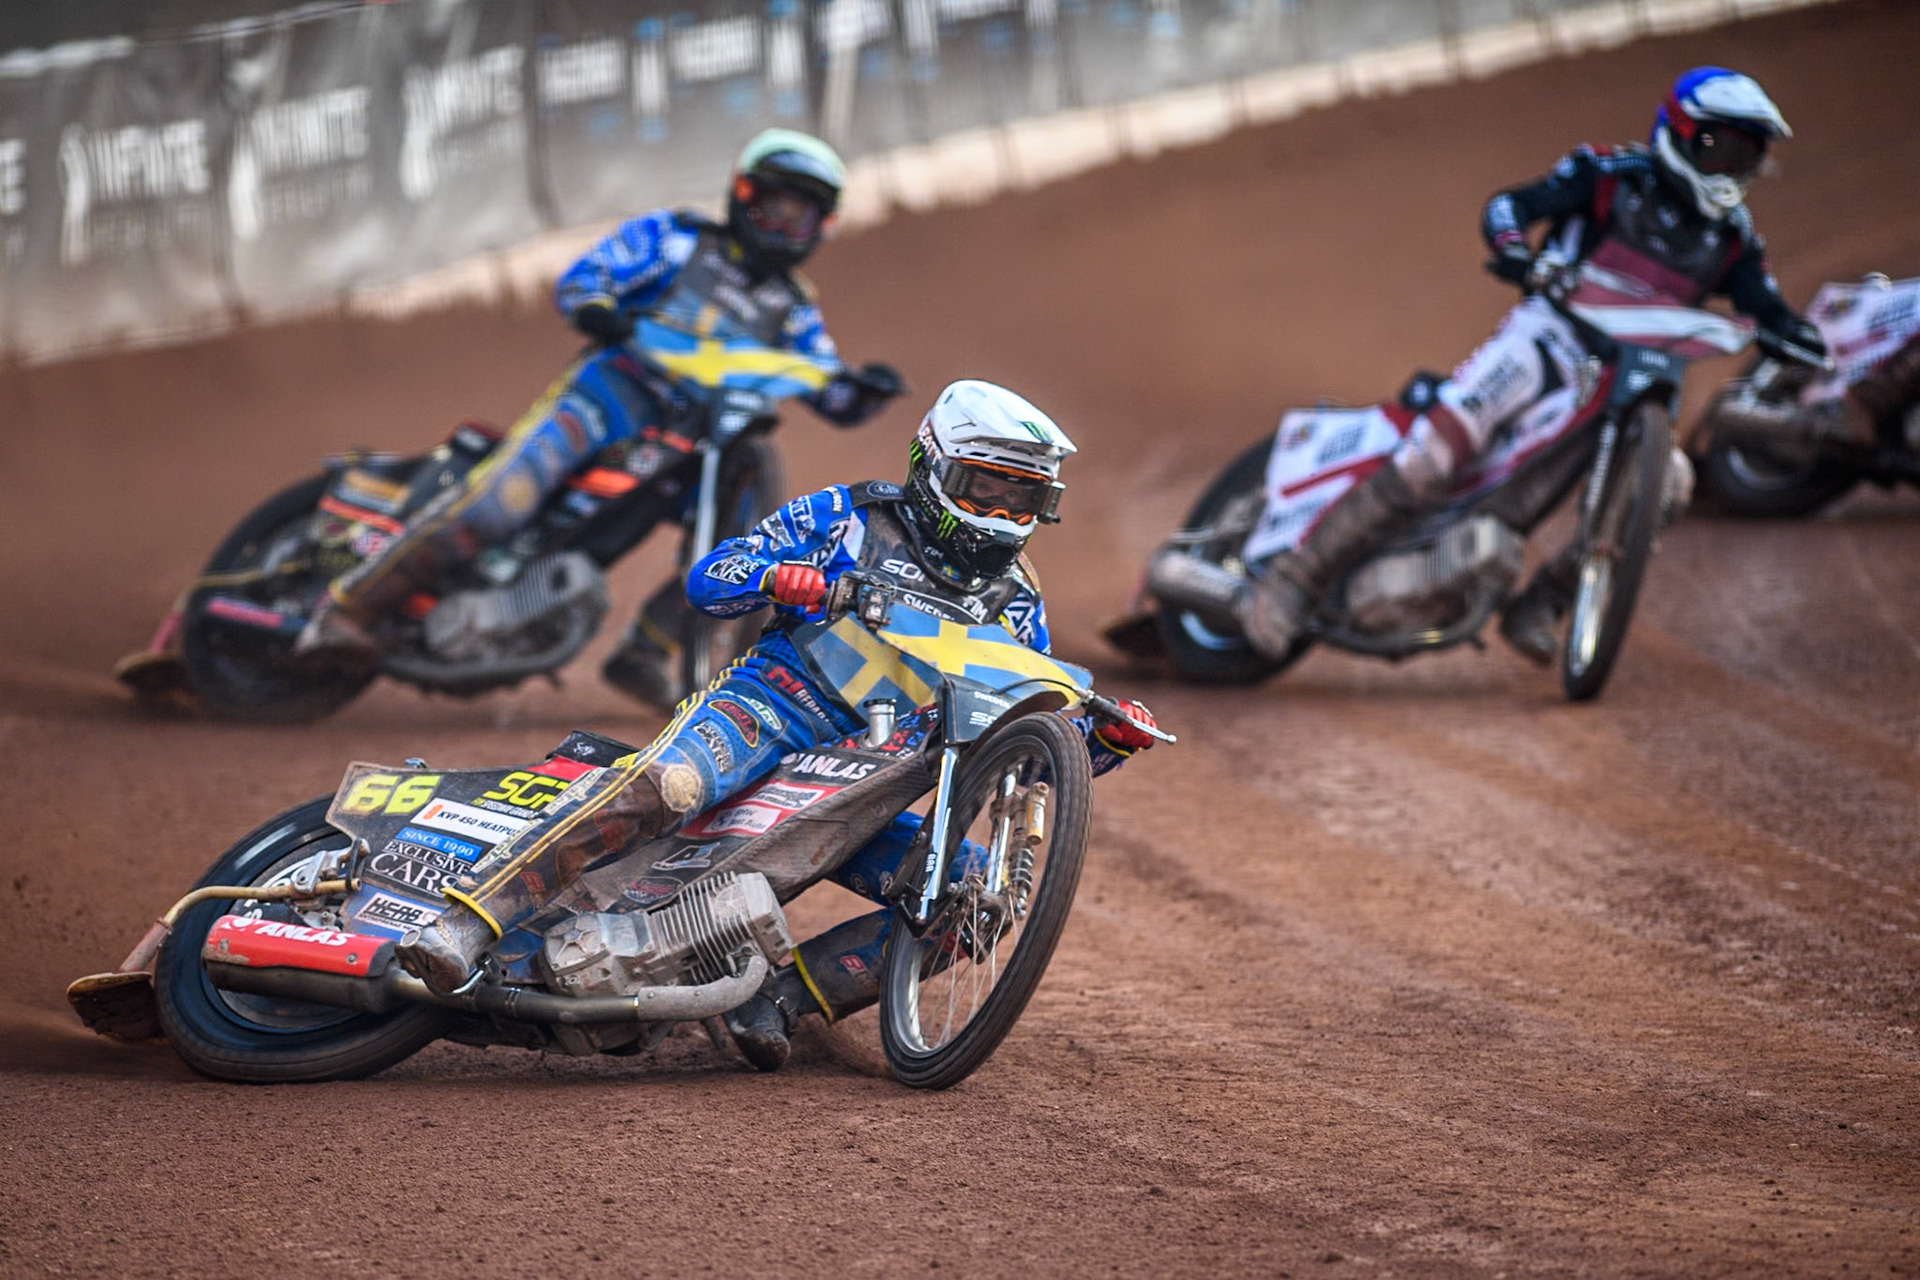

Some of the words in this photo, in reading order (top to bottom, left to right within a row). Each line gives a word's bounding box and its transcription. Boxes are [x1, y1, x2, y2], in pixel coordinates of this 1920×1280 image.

[880, 558, 925, 582] SO
[962, 595, 989, 623] FIM
[792, 753, 877, 780] ANLAS
[343, 774, 441, 815] 66
[437, 807, 459, 820] KVP
[458, 816, 478, 826] 450
[401, 830, 442, 847] SINCE
[443, 840, 474, 857] 1990
[384, 840, 472, 876] EXCLUSIVE
[370, 852, 460, 895] CARS
[255, 923, 355, 947] ANLAS
